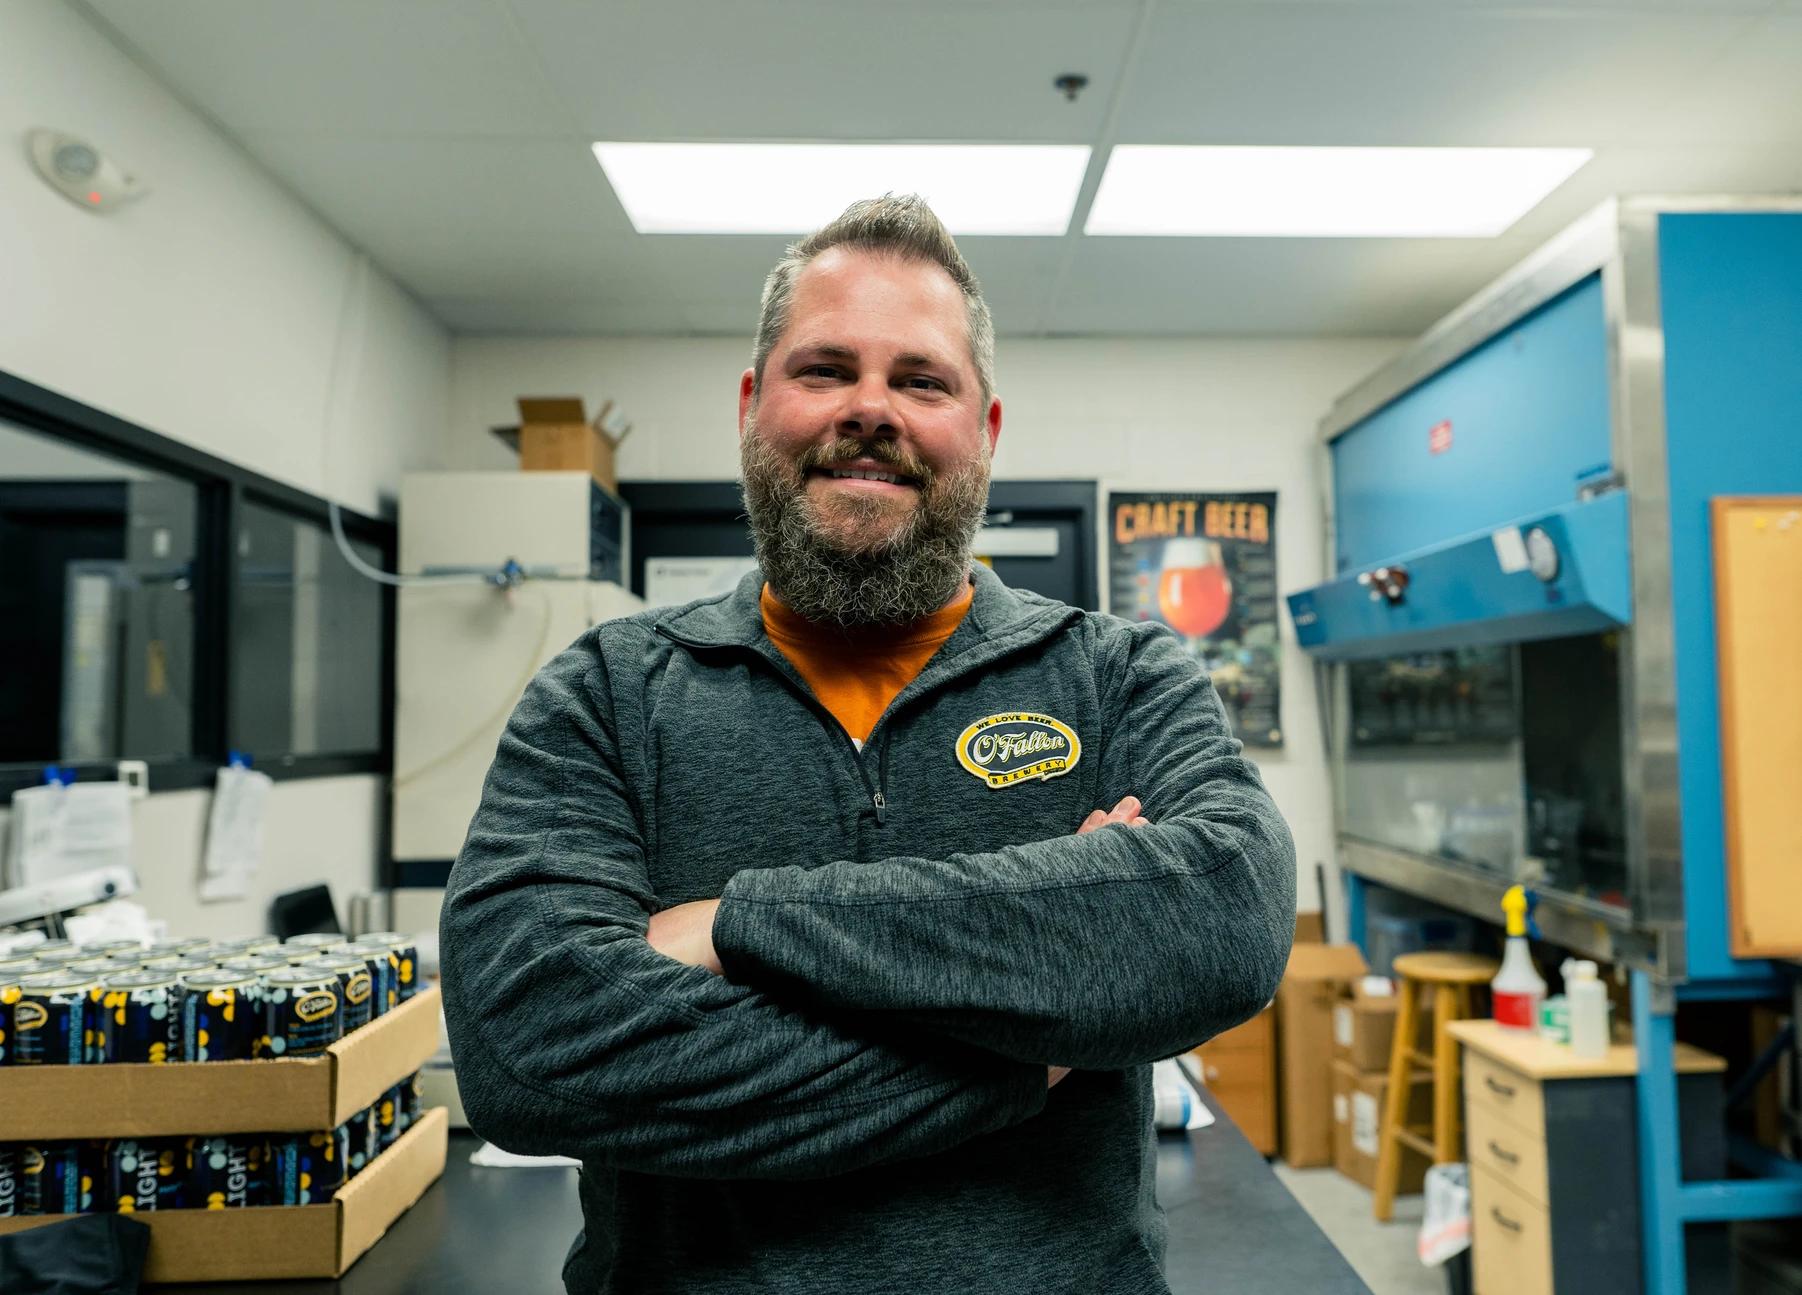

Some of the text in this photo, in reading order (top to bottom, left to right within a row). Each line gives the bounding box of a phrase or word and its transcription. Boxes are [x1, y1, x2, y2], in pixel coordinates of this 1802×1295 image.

[1116, 501, 1268, 544] CRAFT BEER
[976, 721, 990, 730] WE
[995, 715, 1022, 723] LOVE
[973, 731, 1065, 765] O'Fallon
[992, 760, 1062, 784] BREWERY
